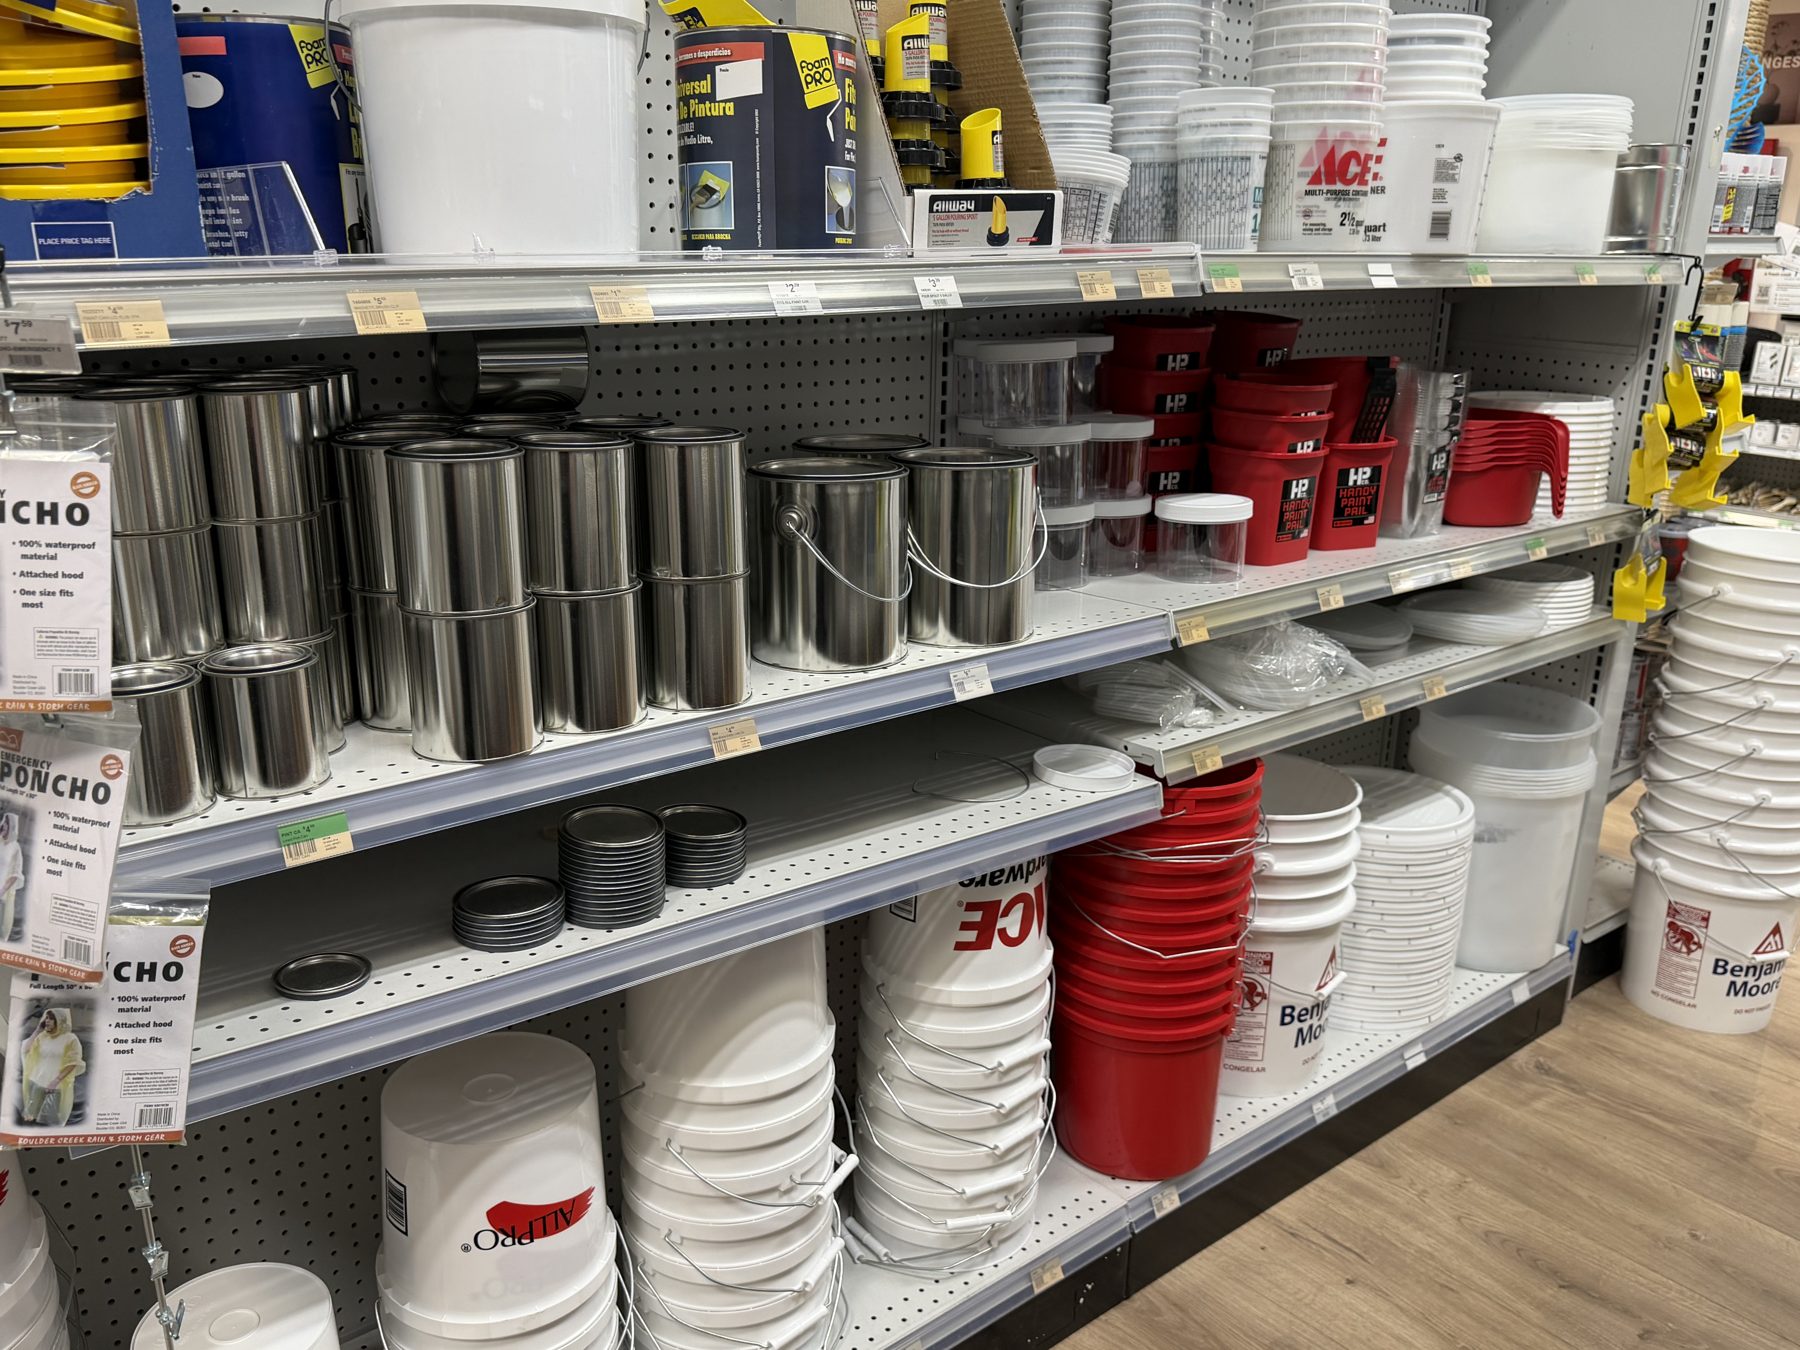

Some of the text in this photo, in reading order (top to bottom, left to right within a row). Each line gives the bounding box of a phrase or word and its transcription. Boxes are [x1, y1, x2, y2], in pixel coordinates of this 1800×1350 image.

[690, 99, 734, 118] Pintura
[697, 134, 714, 145] Litro,
[230, 194, 250, 202] brush
[1304, 189, 1350, 197] MULTI-PURPOSE
[932, 200, 975, 212] Allway
[234, 230, 248, 238] utty
[1348, 466, 1372, 486] HP
[1290, 479, 1308, 499] HP
[1340, 486, 1376, 498] HANDY
[1283, 498, 1312, 512] HANDY
[1341, 496, 1372, 508] PAINT
[0, 500, 90, 526] CHO
[1283, 510, 1308, 522] PAINT
[1344, 507, 1368, 516] PAIL
[1286, 521, 1304, 530] PAIL
[18, 540, 96, 550] 100% waterproof
[20, 552, 58, 560] material
[19, 570, 84, 579] Attached hood
[19, 588, 74, 597] One size fits
[6, 700, 26, 709] RAIN
[38, 702, 65, 710] STORM
[0, 750, 52, 770] EMERGENCY
[0, 761, 112, 805] PONCHO
[53, 810, 111, 828] 100% waterproof
[53, 823, 80, 834] material
[49, 838, 96, 855] Attached hood
[46, 856, 86, 870] One size fits
[46, 868, 62, 877] most
[2, 952, 24, 962] CREEK
[48, 964, 68, 974] STORM
[69, 968, 86, 979] GEAR
[141, 994, 186, 1003] waterproof
[114, 1020, 172, 1028] Attached hood
[131, 1036, 146, 1044] size
[149, 1036, 162, 1044] fits
[1223, 1063, 1266, 1073] CONGELAR
[18, 1137, 55, 1145] BOULDER
[58, 1136, 85, 1144] CREEK
